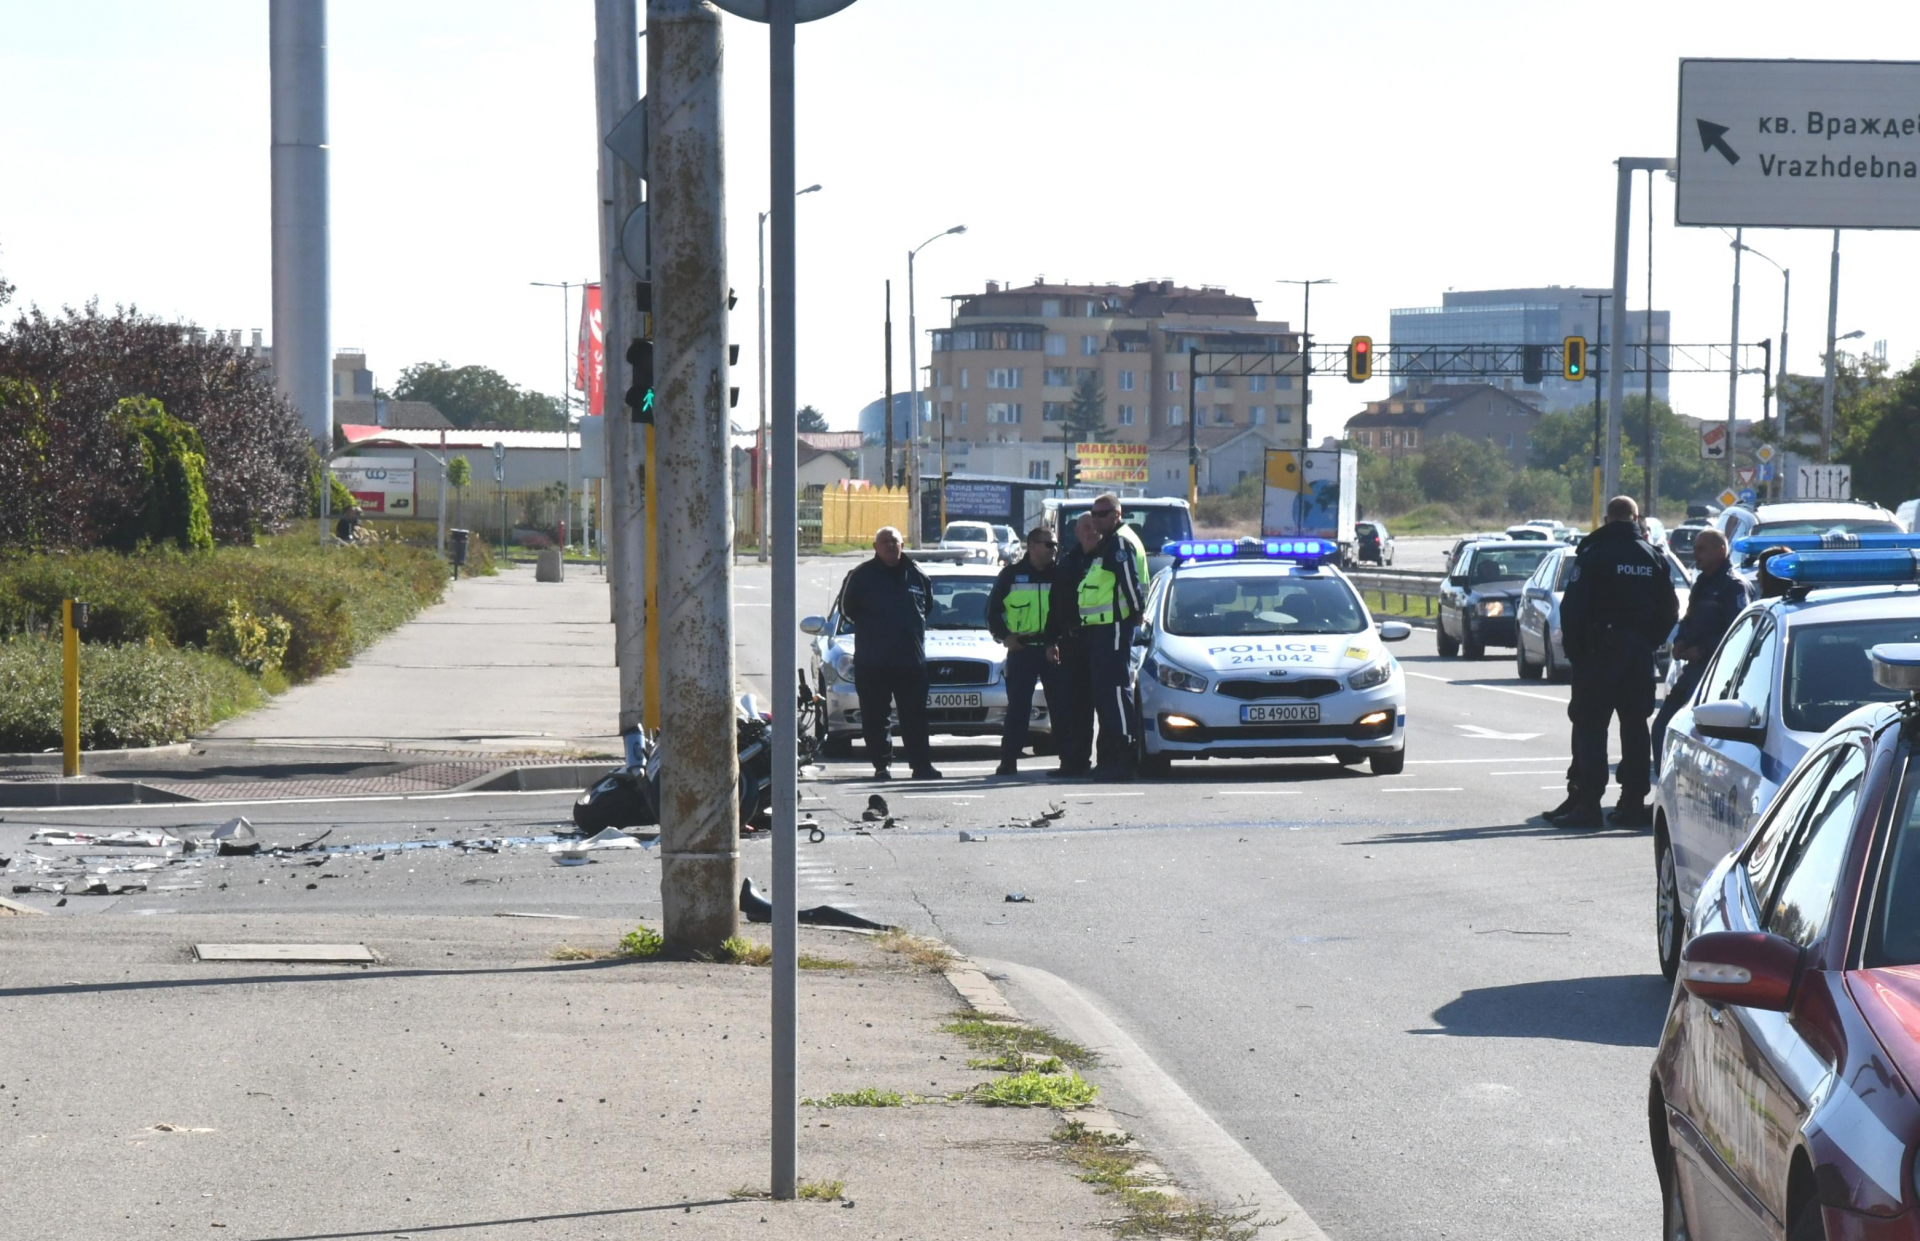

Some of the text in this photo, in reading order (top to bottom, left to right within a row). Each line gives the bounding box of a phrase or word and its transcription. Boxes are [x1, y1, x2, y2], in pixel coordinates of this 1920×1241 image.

[1758, 111, 1920, 141] кв. Вражде
[1758, 153, 1917, 178] Vrazhdebna
[1077, 444, 1147, 454] МАГАЗИН
[1080, 458, 1147, 467] МЕТАЛИ
[1080, 470, 1145, 480] ОТВОРЕНО
[1616, 564, 1653, 577] POLICE
[1208, 643, 1330, 656] POLICE
[1231, 654, 1314, 665] 24-1042
[934, 693, 962, 706] 4000
[963, 693, 979, 706] HB
[1249, 706, 1317, 720] CB 4900 KB
